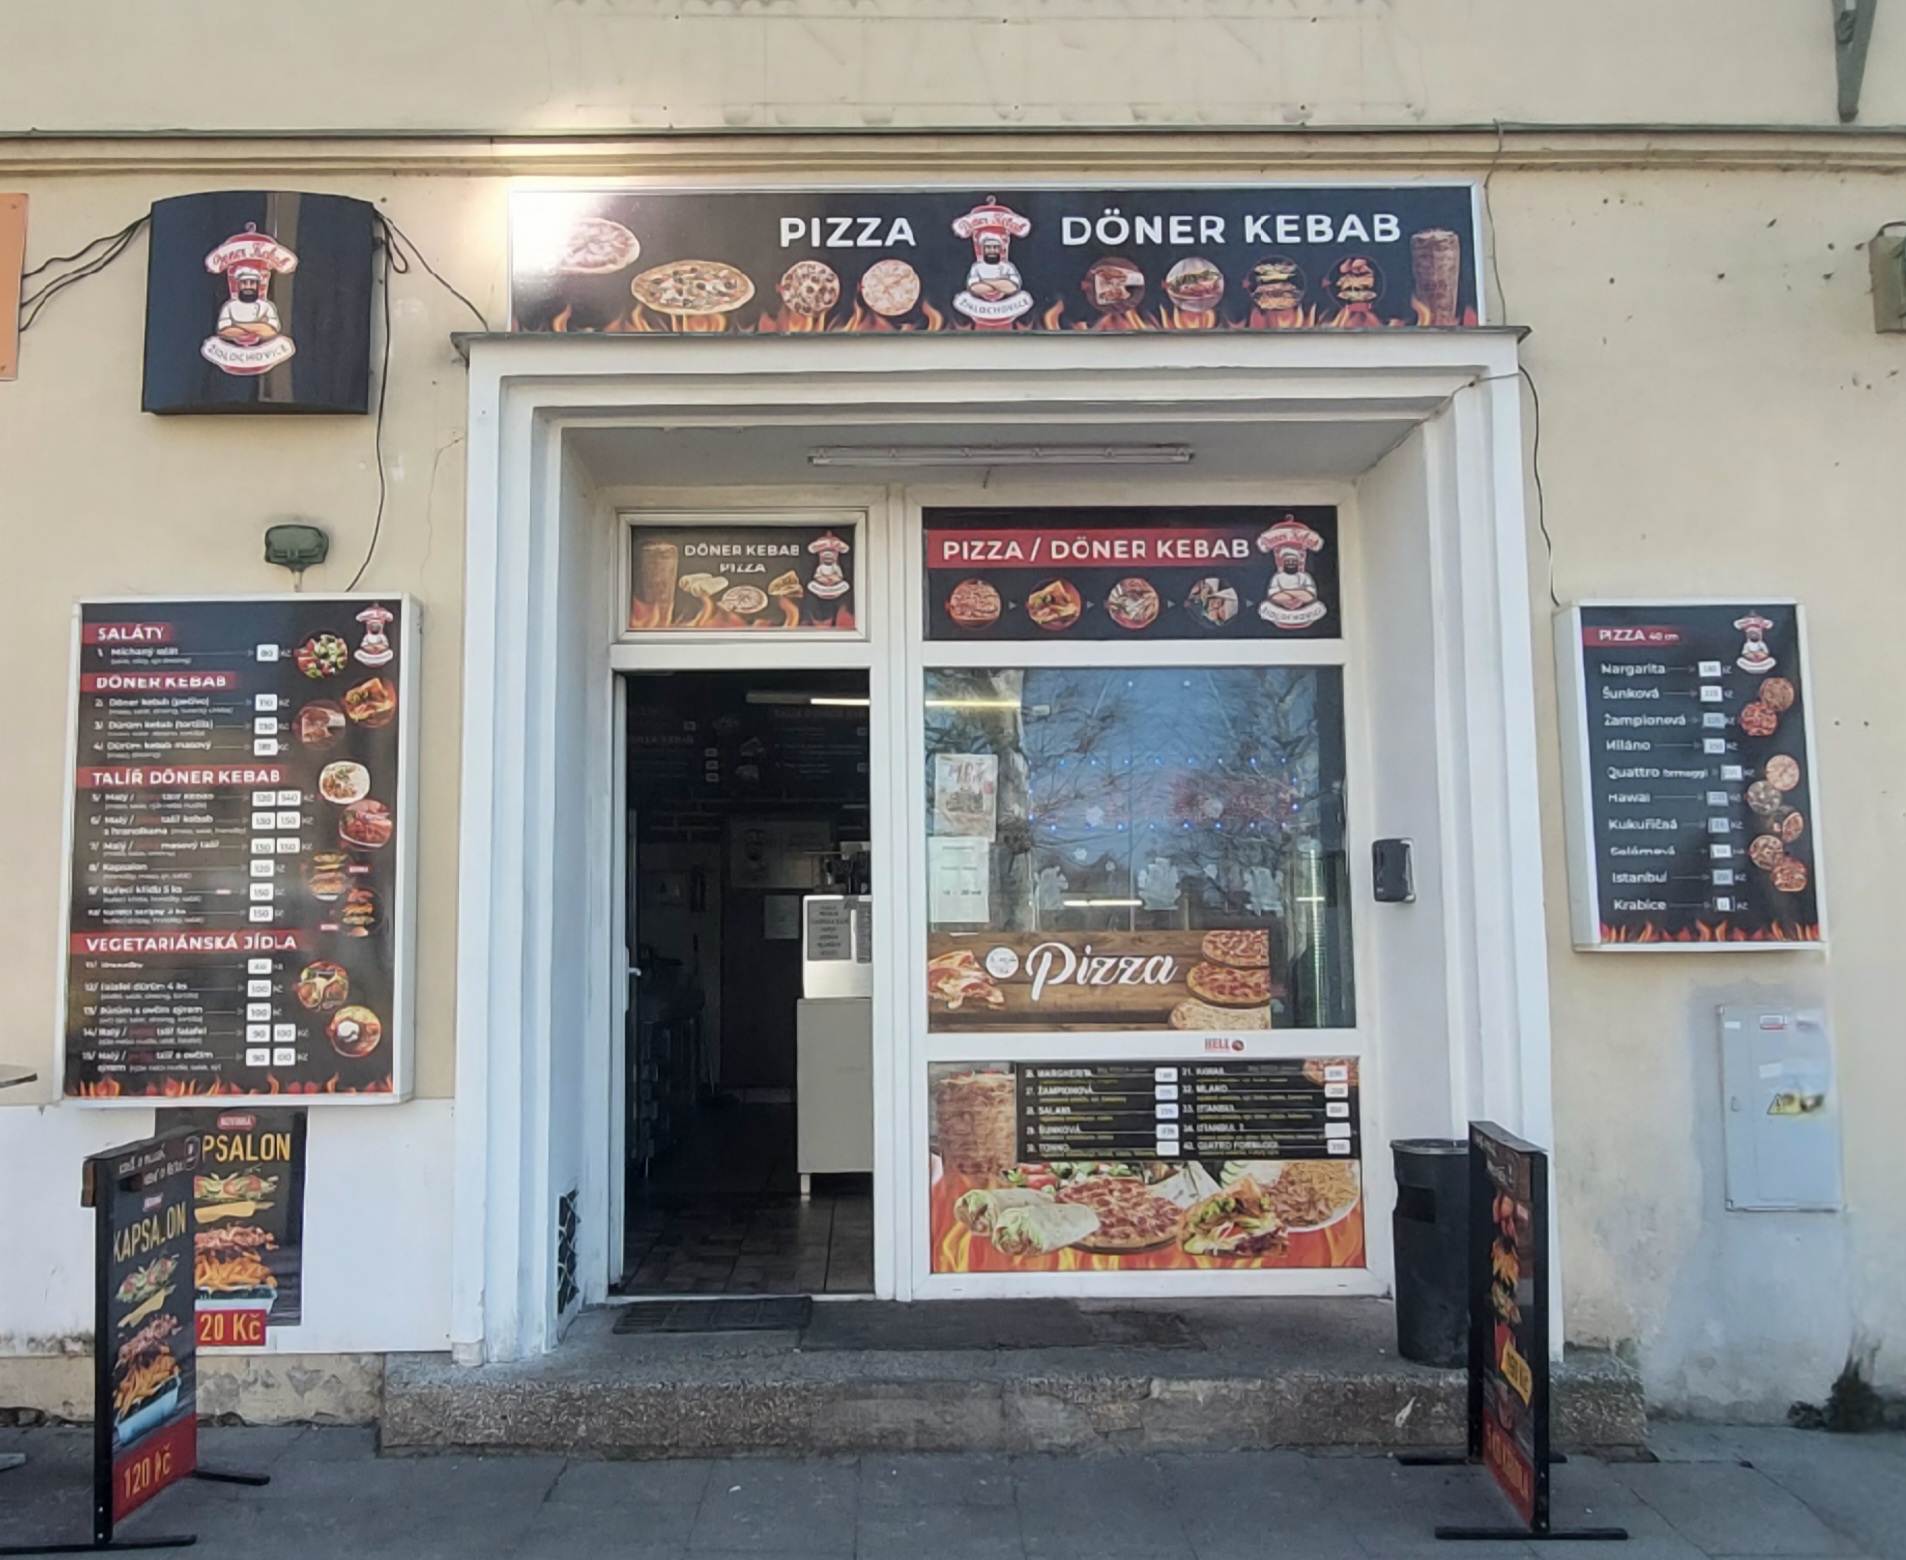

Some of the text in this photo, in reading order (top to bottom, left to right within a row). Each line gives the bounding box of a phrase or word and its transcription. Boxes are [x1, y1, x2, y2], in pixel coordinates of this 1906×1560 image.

[779, 217, 917, 248] PIZZA
[1061, 208, 1401, 246] DÖNER KEBAB
[685, 543, 800, 557] DÖNER KEBAB
[943, 536, 1250, 563] PIZZA / DÖNER KEBAB
[719, 564, 767, 573] PIZZA
[98, 623, 164, 641] SALÁTY
[1599, 629, 1646, 641] PIZZA
[96, 676, 227, 689] DÖNER KEBAB
[1602, 687, 1660, 700] Šunková
[92, 768, 281, 785] TALÍŘ DÖNER KEBAB
[1608, 767, 1660, 780] Quattro
[1612, 872, 1667, 883] Istanbul
[1614, 900, 1667, 911] Krabice
[86, 932, 297, 952] VEGETARIÁNSKÁ JÍDLA
[1025, 942, 1178, 1001] Pizza
[1205, 1038, 1230, 1050] HELL
[233, 1313, 262, 1342] Kč
[124, 1457, 150, 1500] 120
